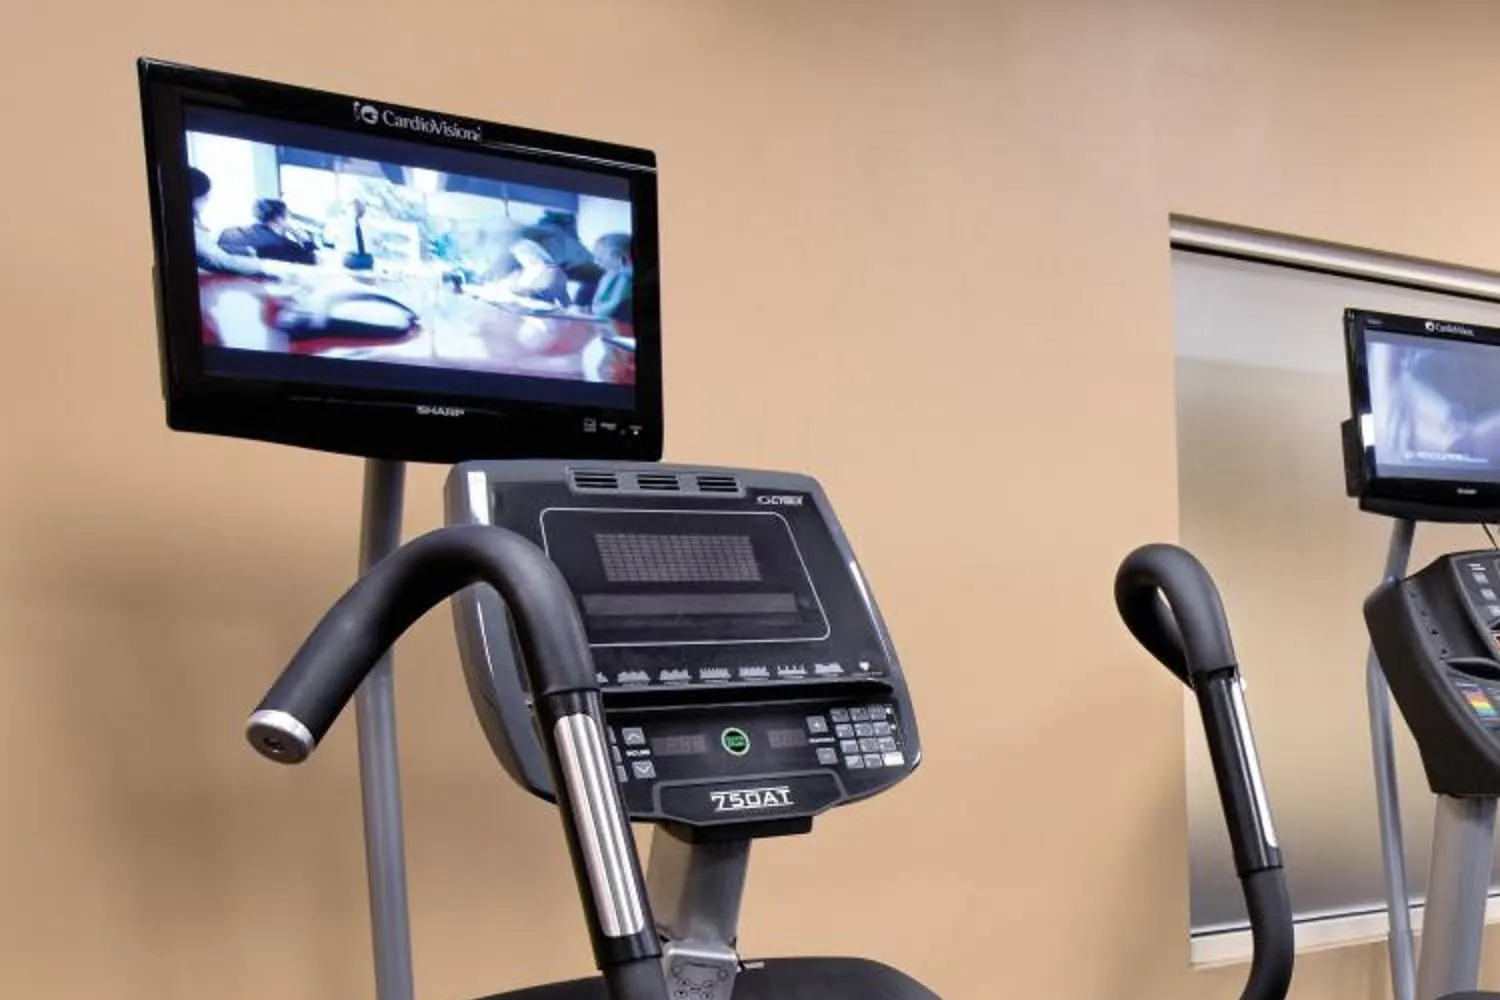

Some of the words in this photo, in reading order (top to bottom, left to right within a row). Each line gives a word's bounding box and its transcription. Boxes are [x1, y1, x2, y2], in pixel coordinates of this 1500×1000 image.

[382, 109, 480, 141] CardioVision
[416, 405, 465, 417] SHARP
[710, 786, 795, 812] 750AT
